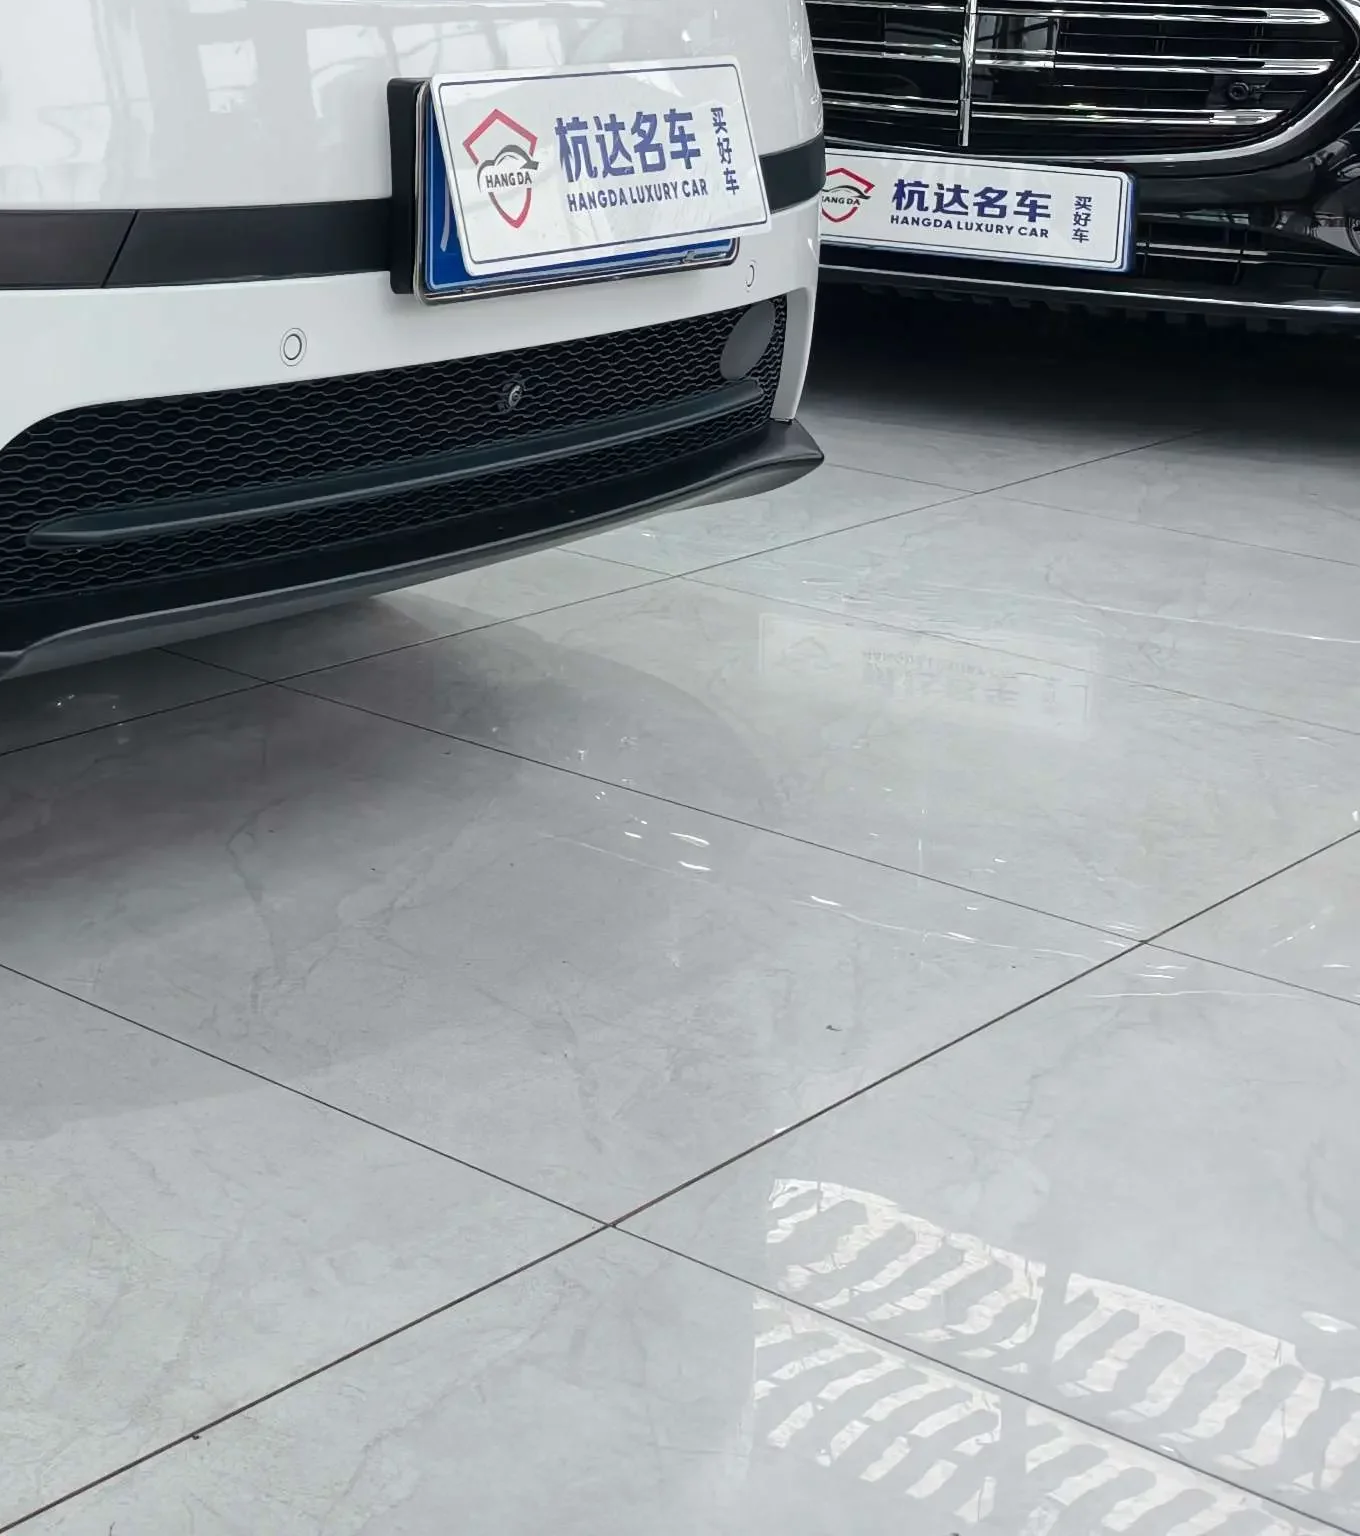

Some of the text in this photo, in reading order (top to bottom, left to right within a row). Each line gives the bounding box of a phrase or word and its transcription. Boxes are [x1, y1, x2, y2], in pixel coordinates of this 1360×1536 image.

[554, 107, 702, 184] 杭达名车
[710, 106, 741, 197] 买好车
[484, 169, 533, 190] HANG DA
[566, 177, 710, 213] HANGDA LUXURY CAR
[846, 198, 861, 207] DA
[891, 178, 1053, 224] 杭达名车
[1070, 194, 1093, 245] 买好车
[890, 214, 1050, 240] HANGDA LUXURY CAR
